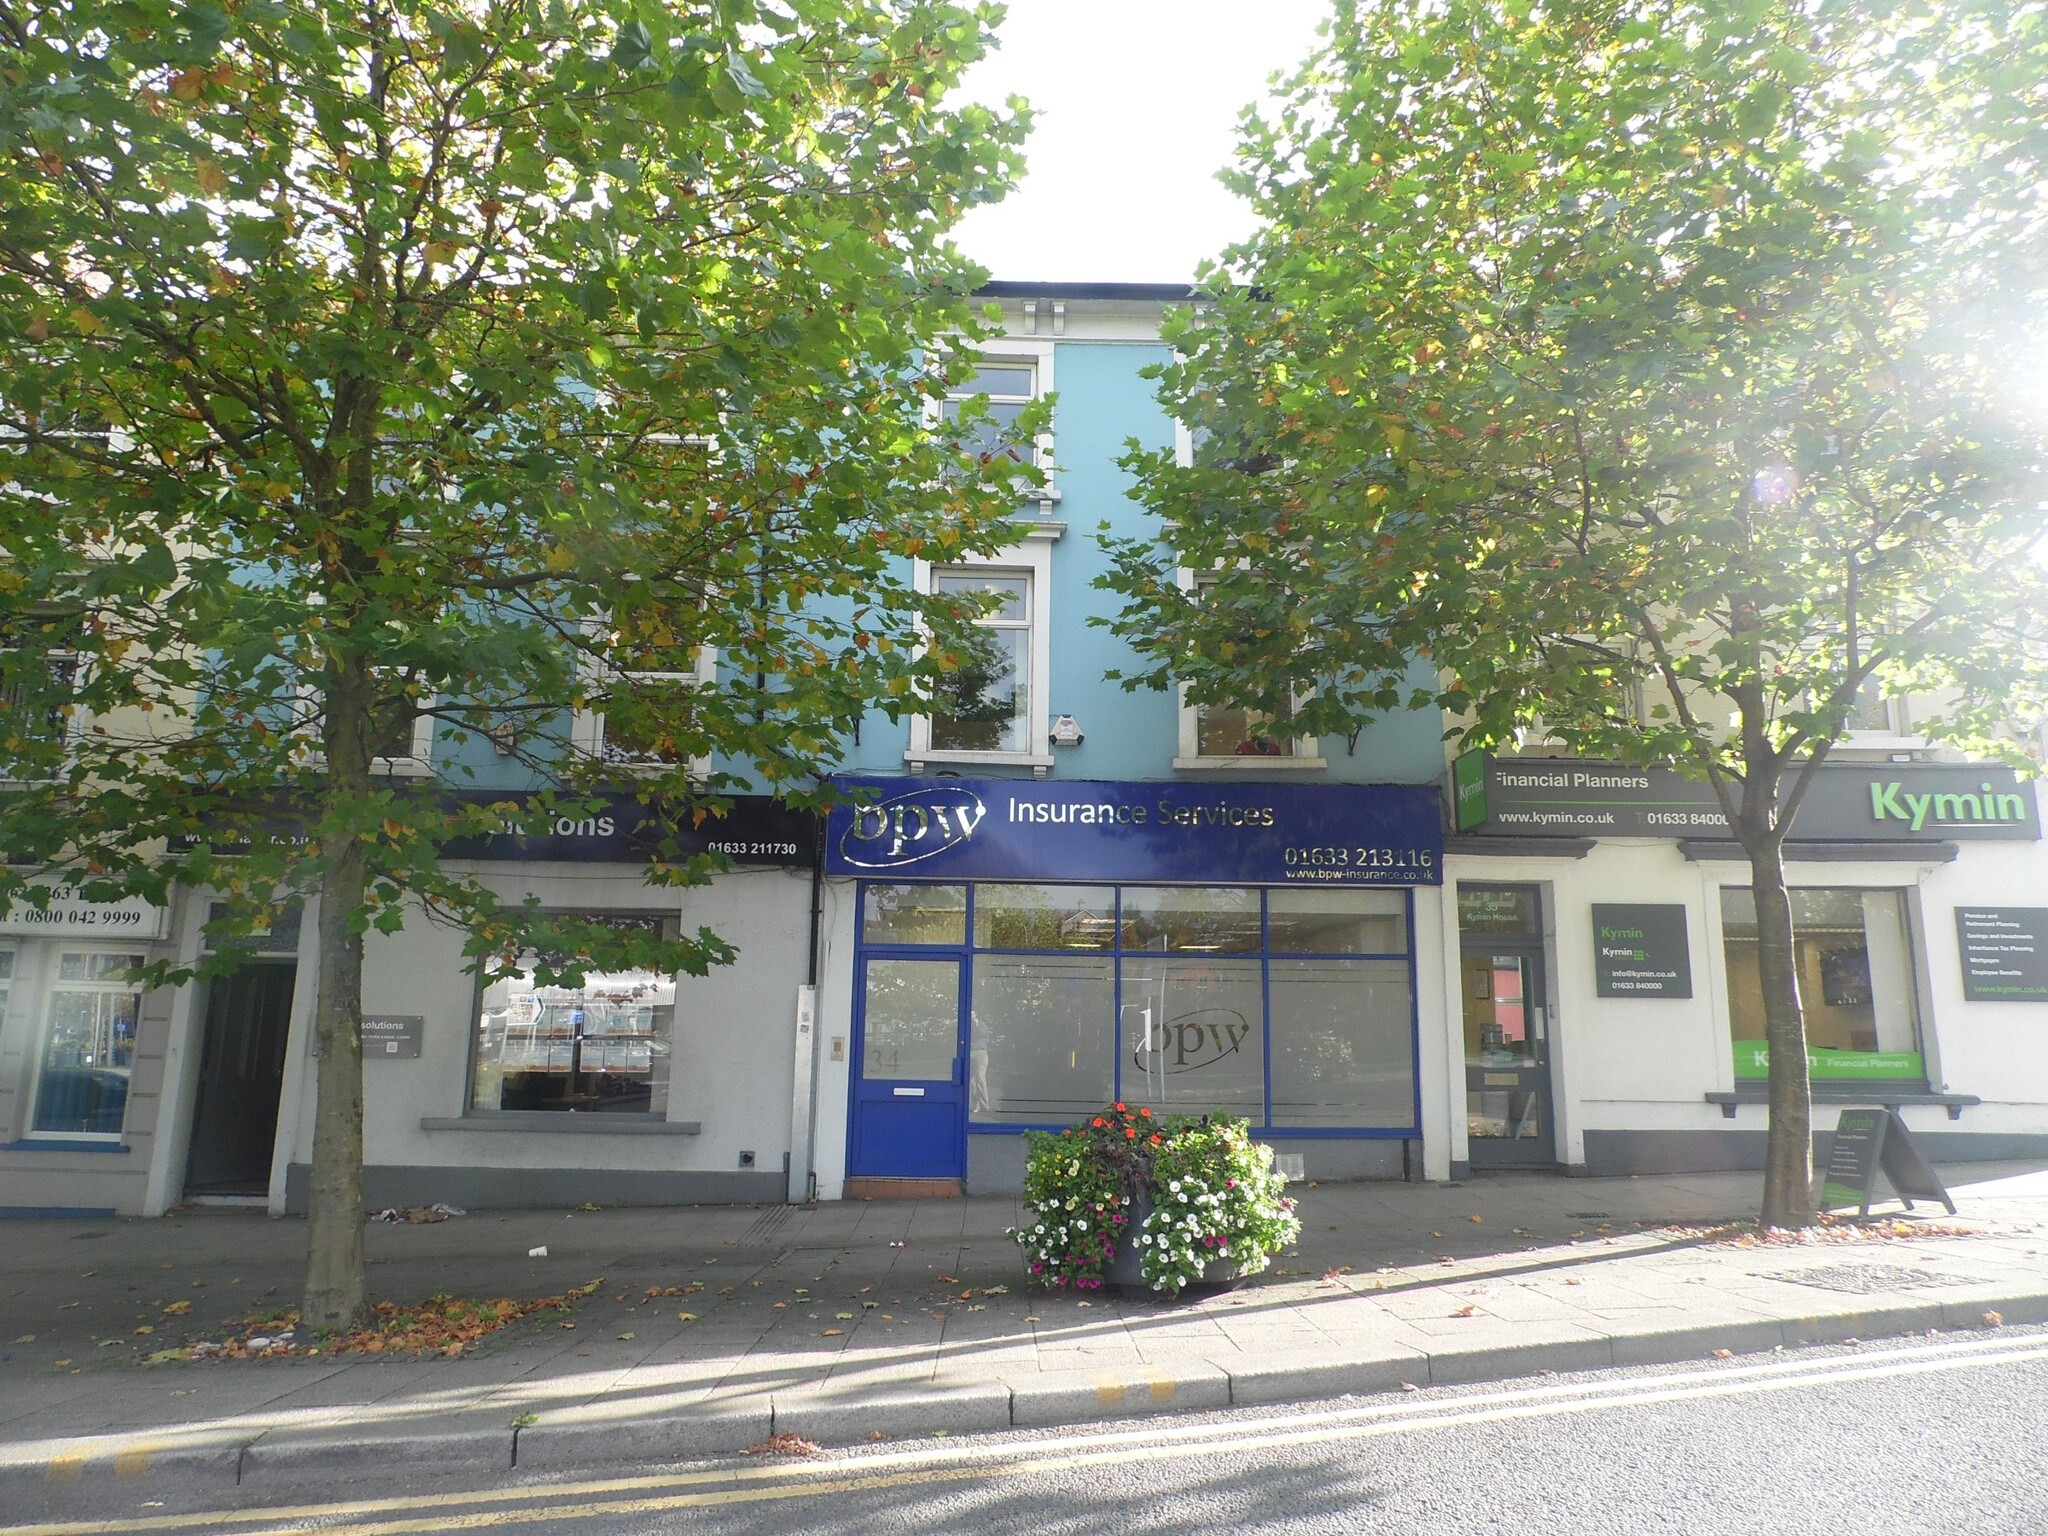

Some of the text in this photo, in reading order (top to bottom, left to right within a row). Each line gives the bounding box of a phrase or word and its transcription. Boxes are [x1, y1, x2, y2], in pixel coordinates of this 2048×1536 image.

[1573, 773, 1649, 789] Planners
[1459, 777, 1484, 803] Kymin
[1009, 798, 1147, 825] Insurance
[1870, 782, 2026, 831] Kymin
[1157, 800, 1275, 827] Services
[1647, 813, 1687, 825] 01633
[853, 803, 981, 856] bpw
[708, 842, 797, 855] 01633 211730
[1284, 848, 1432, 867] 01633 213116
[1285, 868, 1433, 881] www.bpw-insurance.co.uk
[46, 886, 71, 900] 63
[1485, 903, 1498, 911] 35
[25, 909, 63, 924] 0800
[68, 910, 96, 924] 042
[102, 911, 141, 925] 9999
[1466, 913, 1519, 922] Kymin House
[1601, 927, 1643, 940] Kymin
[1602, 947, 1633, 957] Kymin
[1611, 970, 1677, 978] info@kymin.co.uk
[1974, 986, 2047, 994] www.kymin.co.uk
[361, 1021, 404, 1029] solutions
[1140, 1009, 1245, 1065] bpw
[869, 1049, 900, 1073] 34
[1827, 1059, 1909, 1068] Financial Planners
